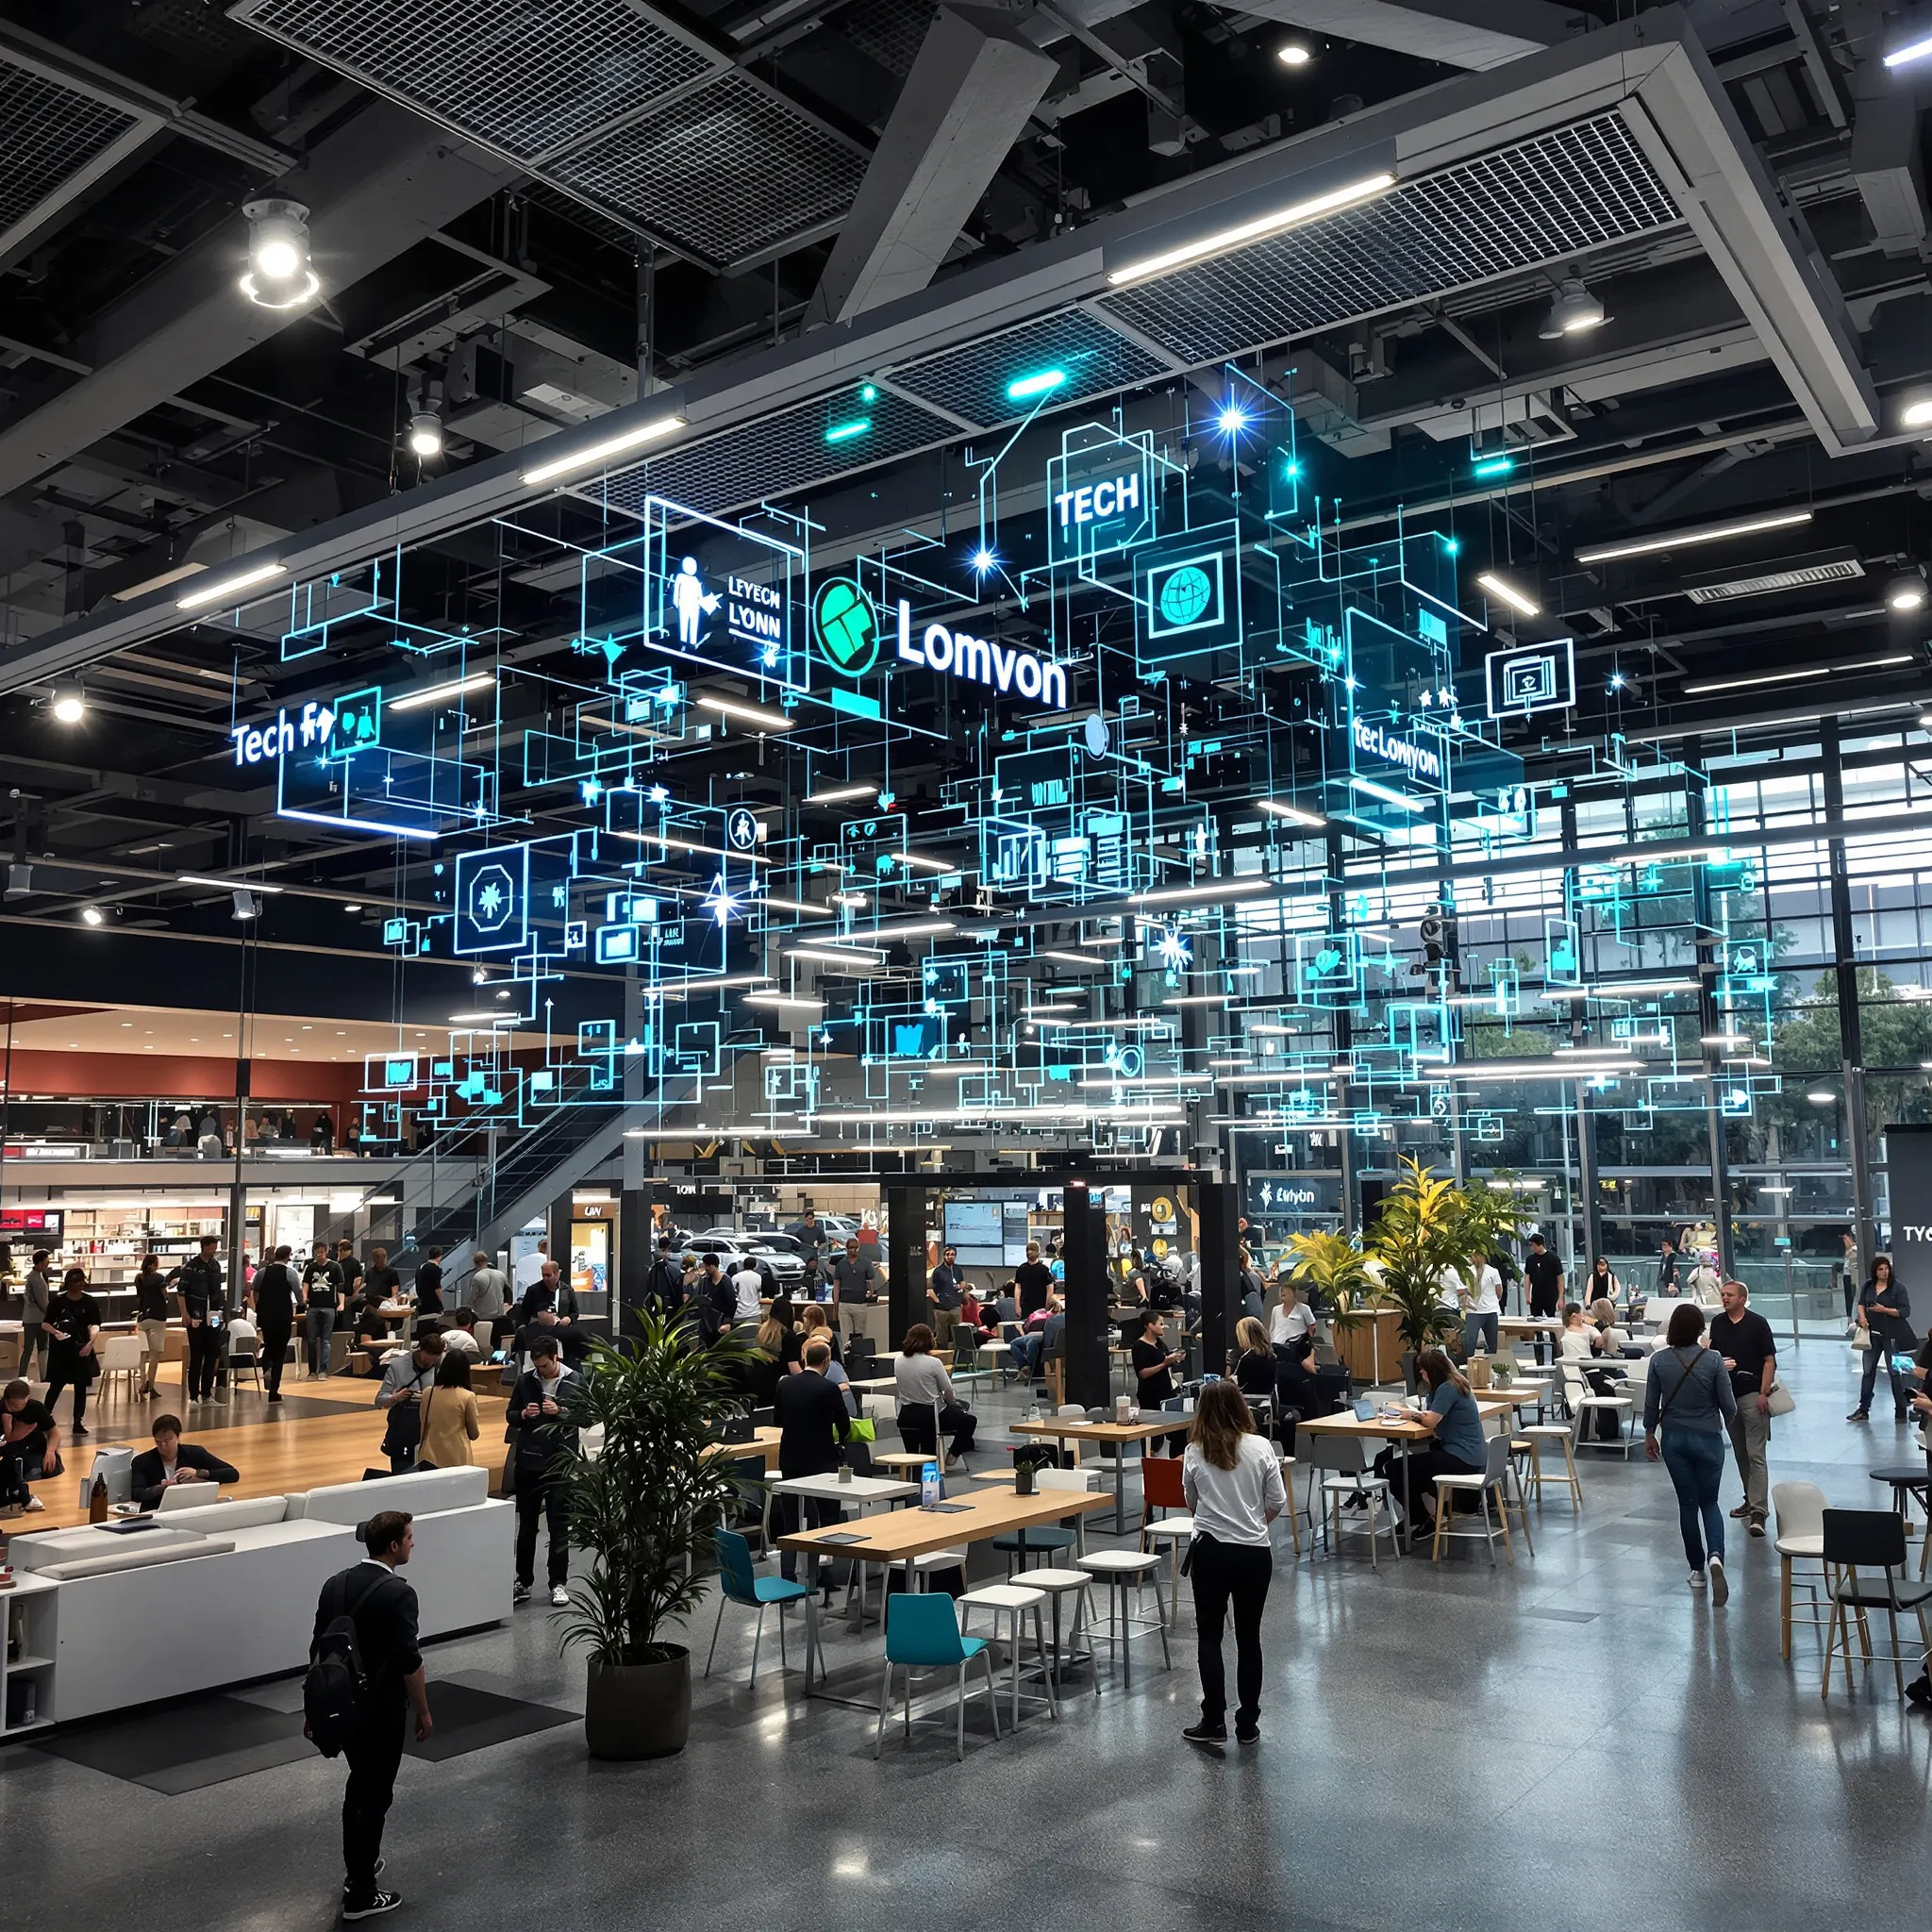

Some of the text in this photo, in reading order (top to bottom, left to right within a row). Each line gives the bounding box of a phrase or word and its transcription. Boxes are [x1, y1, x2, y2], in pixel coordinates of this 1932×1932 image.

[1055, 474, 1139, 526] TECH
[899, 599, 1067, 709] Lomvon
[232, 709, 294, 766] Tech
